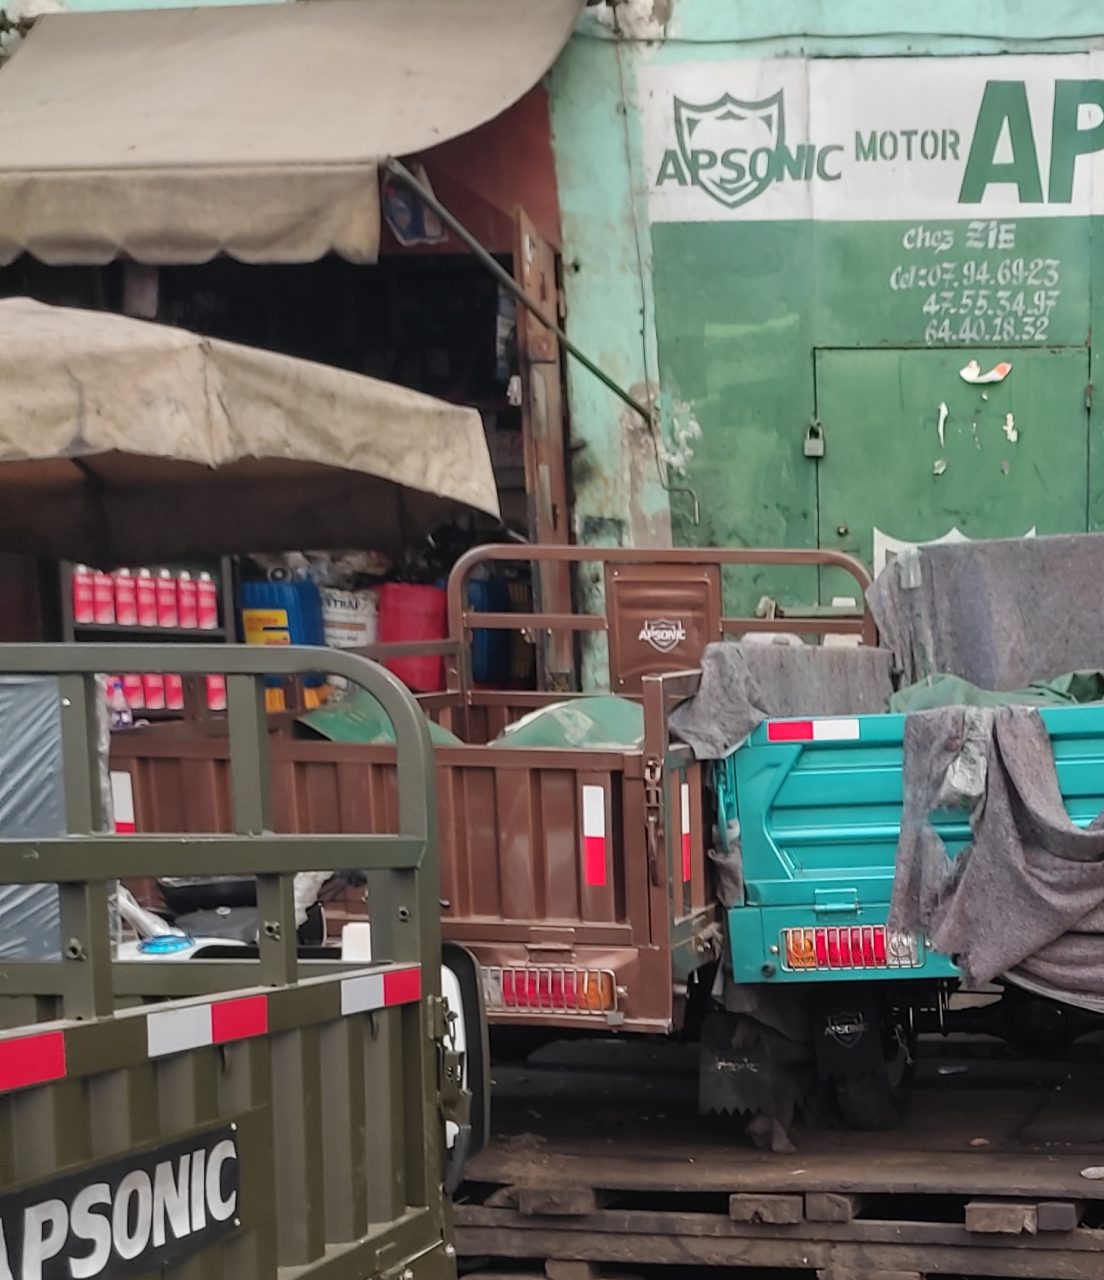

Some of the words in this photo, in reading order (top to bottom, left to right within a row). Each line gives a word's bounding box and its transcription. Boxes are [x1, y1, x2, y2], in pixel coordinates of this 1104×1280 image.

[855, 129, 961, 164] MOTOR
[655, 144, 845, 188] APSONIC
[637, 629, 687, 641] APSONIC
